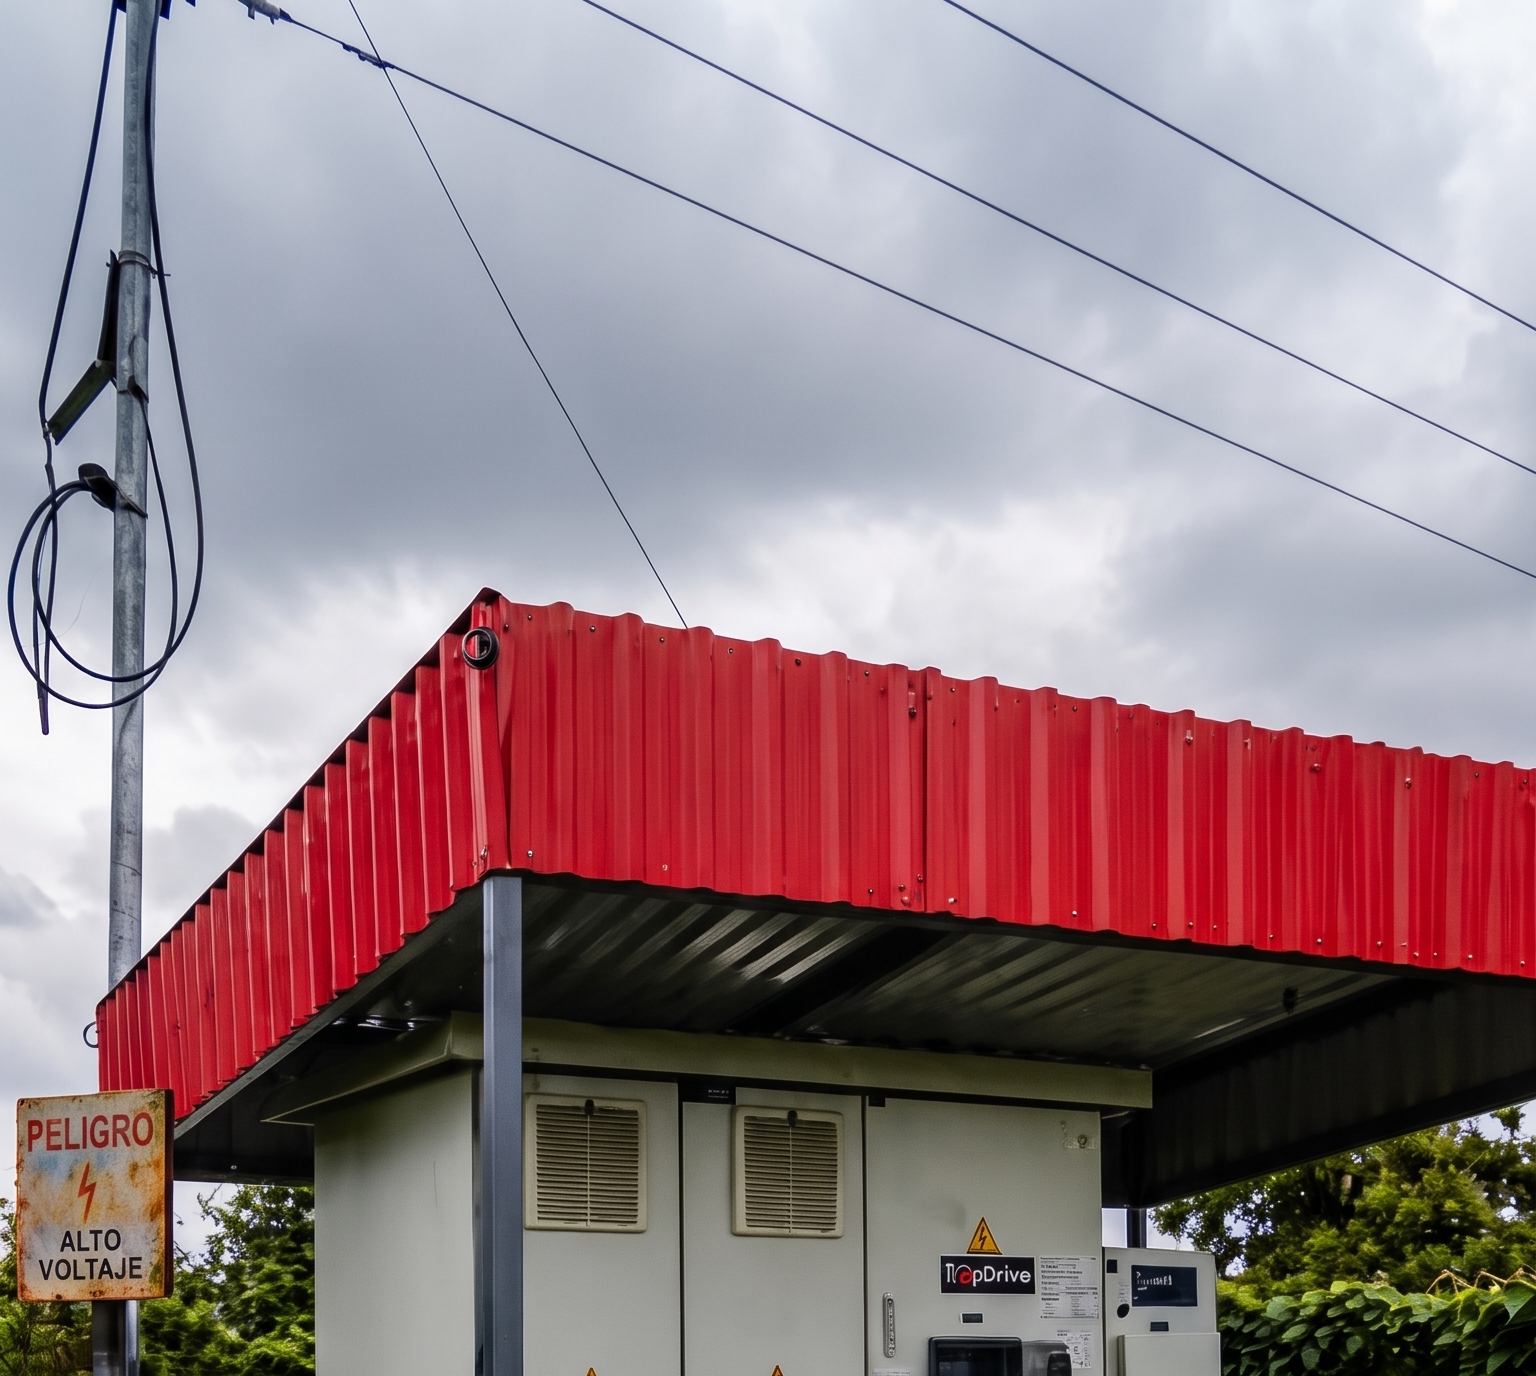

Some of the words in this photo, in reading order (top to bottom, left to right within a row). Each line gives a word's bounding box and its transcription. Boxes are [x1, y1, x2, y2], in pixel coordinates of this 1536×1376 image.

[27, 1112, 154, 1152] PELIGRO
[60, 1229, 121, 1252] ALTO
[38, 1257, 143, 1281] VOLTAJE
